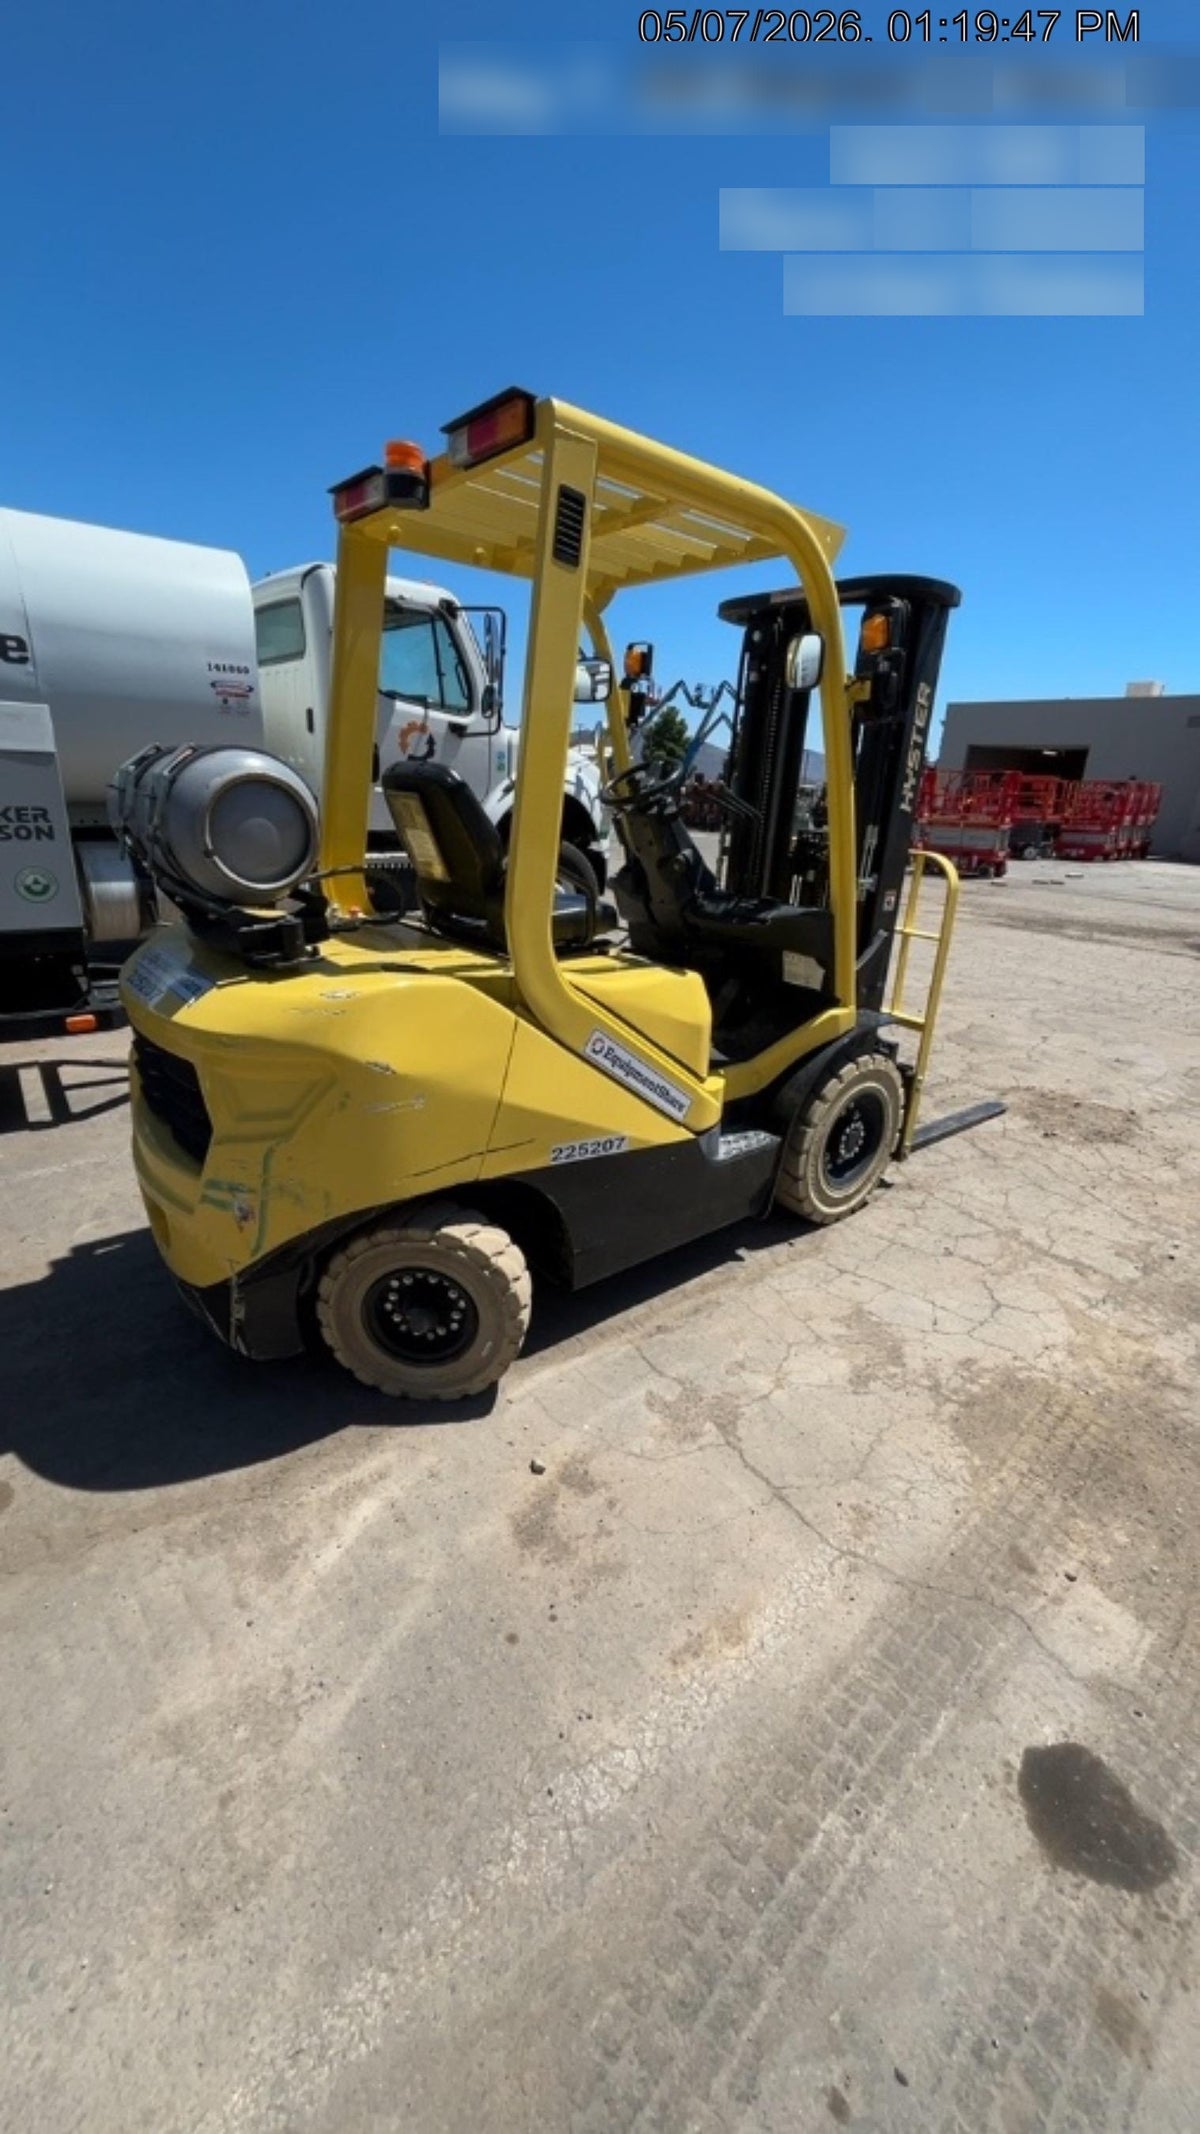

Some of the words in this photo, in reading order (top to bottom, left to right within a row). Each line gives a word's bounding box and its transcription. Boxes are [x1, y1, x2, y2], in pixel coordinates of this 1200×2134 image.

[900, 682, 931, 813] HYSTER
[603, 1046, 686, 1113] EquipmentShare
[552, 1135, 627, 1162] 225207
